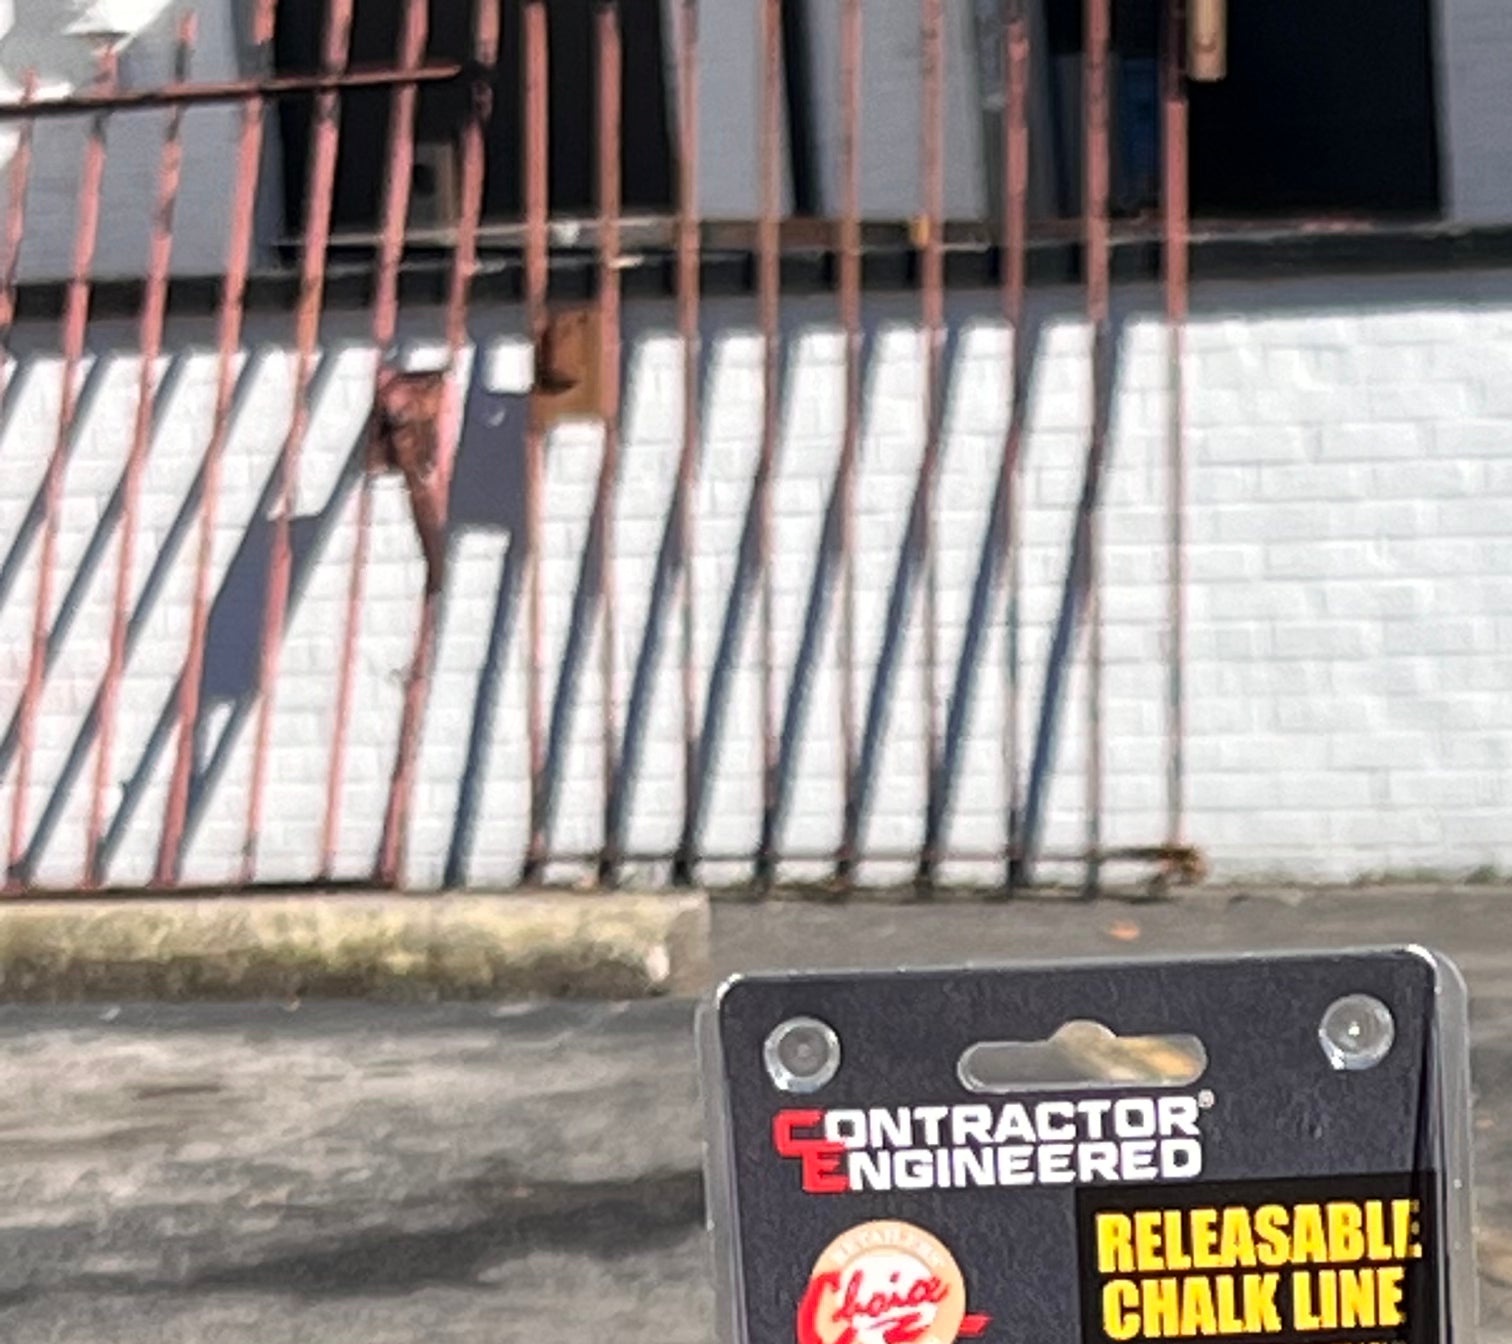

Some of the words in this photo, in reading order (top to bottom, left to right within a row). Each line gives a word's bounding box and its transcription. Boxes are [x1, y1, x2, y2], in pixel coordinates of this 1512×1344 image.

[772, 1096, 1200, 1157] CONTRACTOR
[802, 1138, 1203, 1194] ENGINEERED
[1102, 1273, 1282, 1340] CHALK
[1293, 1266, 1406, 1331] LINE
